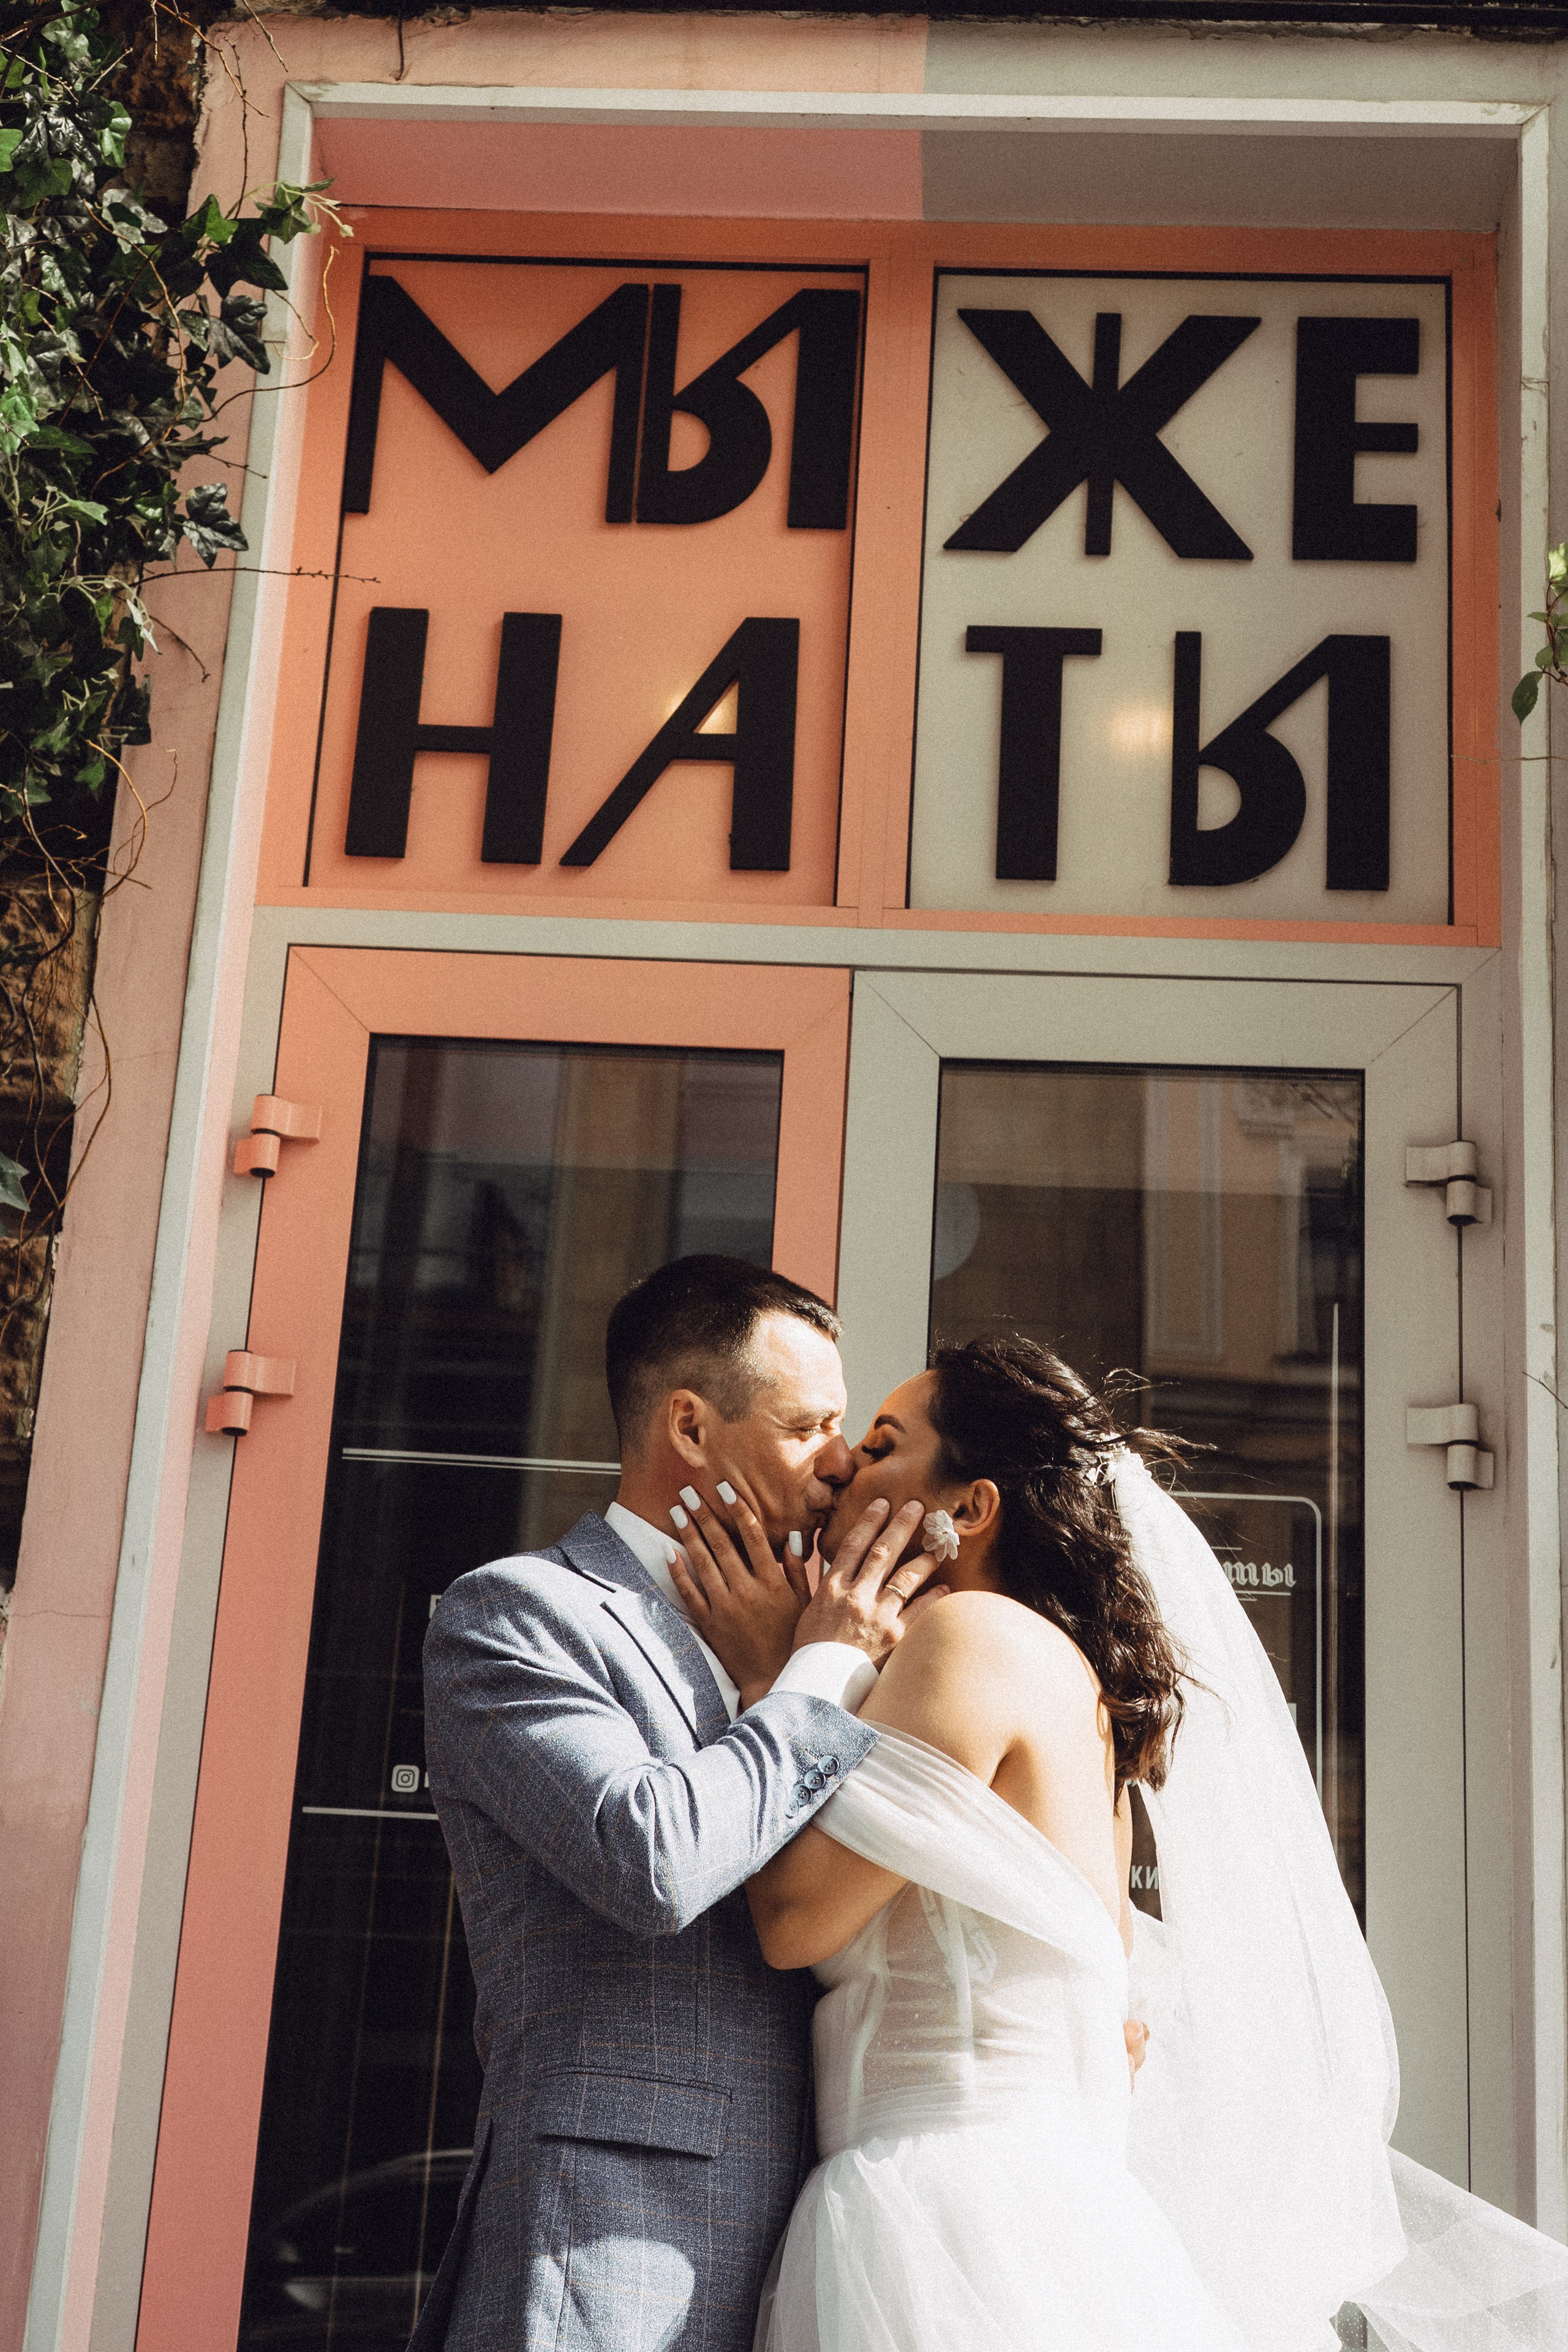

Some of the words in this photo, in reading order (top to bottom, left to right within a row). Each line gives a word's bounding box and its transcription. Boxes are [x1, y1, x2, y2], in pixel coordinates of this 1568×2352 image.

[342, 275, 861, 530] МЫ
[944, 308, 1420, 563] ЖЕ
[344, 606, 800, 872] НА
[965, 626, 1390, 891] ТЫ
